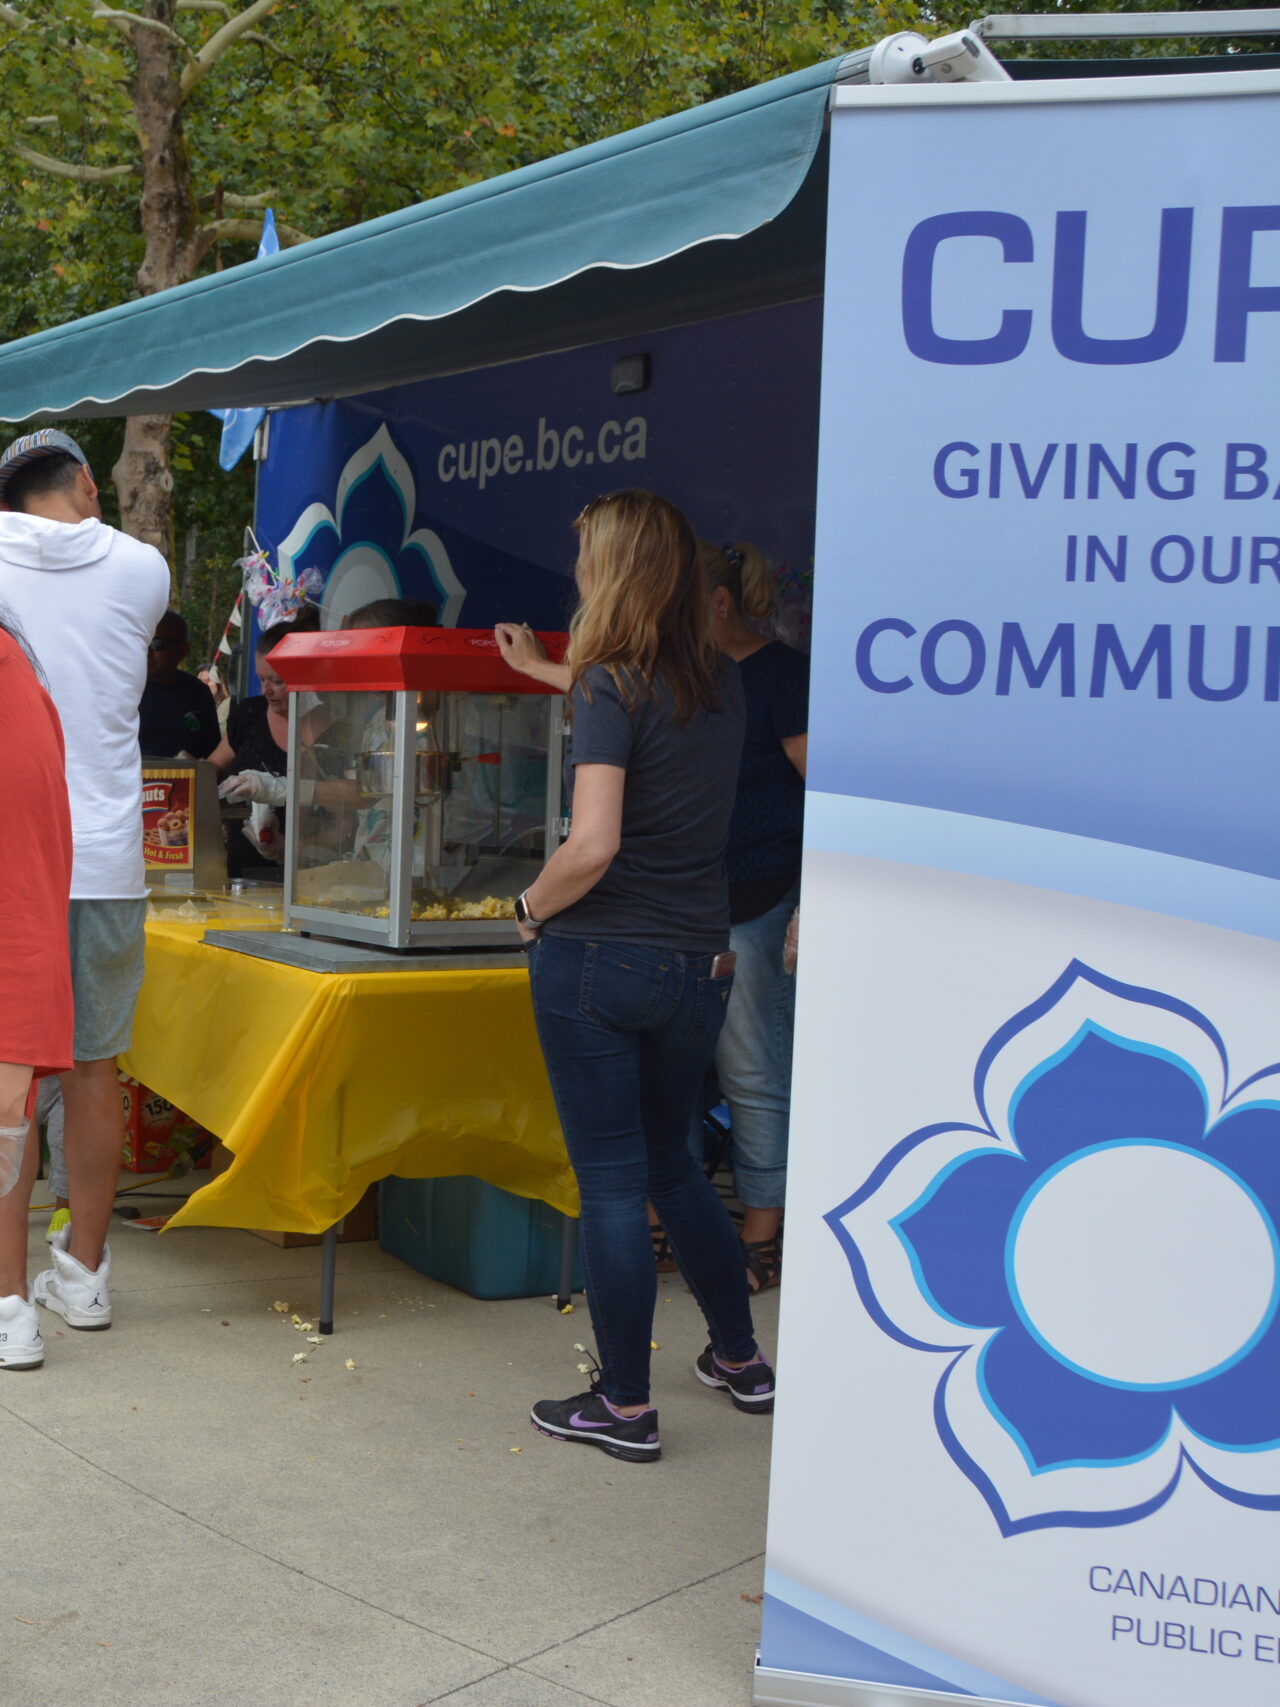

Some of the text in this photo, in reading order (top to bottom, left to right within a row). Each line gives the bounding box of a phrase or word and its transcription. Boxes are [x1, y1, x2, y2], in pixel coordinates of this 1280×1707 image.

[438, 416, 648, 490] cupe.bc.ca
[933, 441, 1197, 500] GIVING
[1065, 534, 1280, 585] IN OUR
[1089, 1565, 1280, 1616] CANADIAN
[1111, 1614, 1242, 1658] PUBLIC
